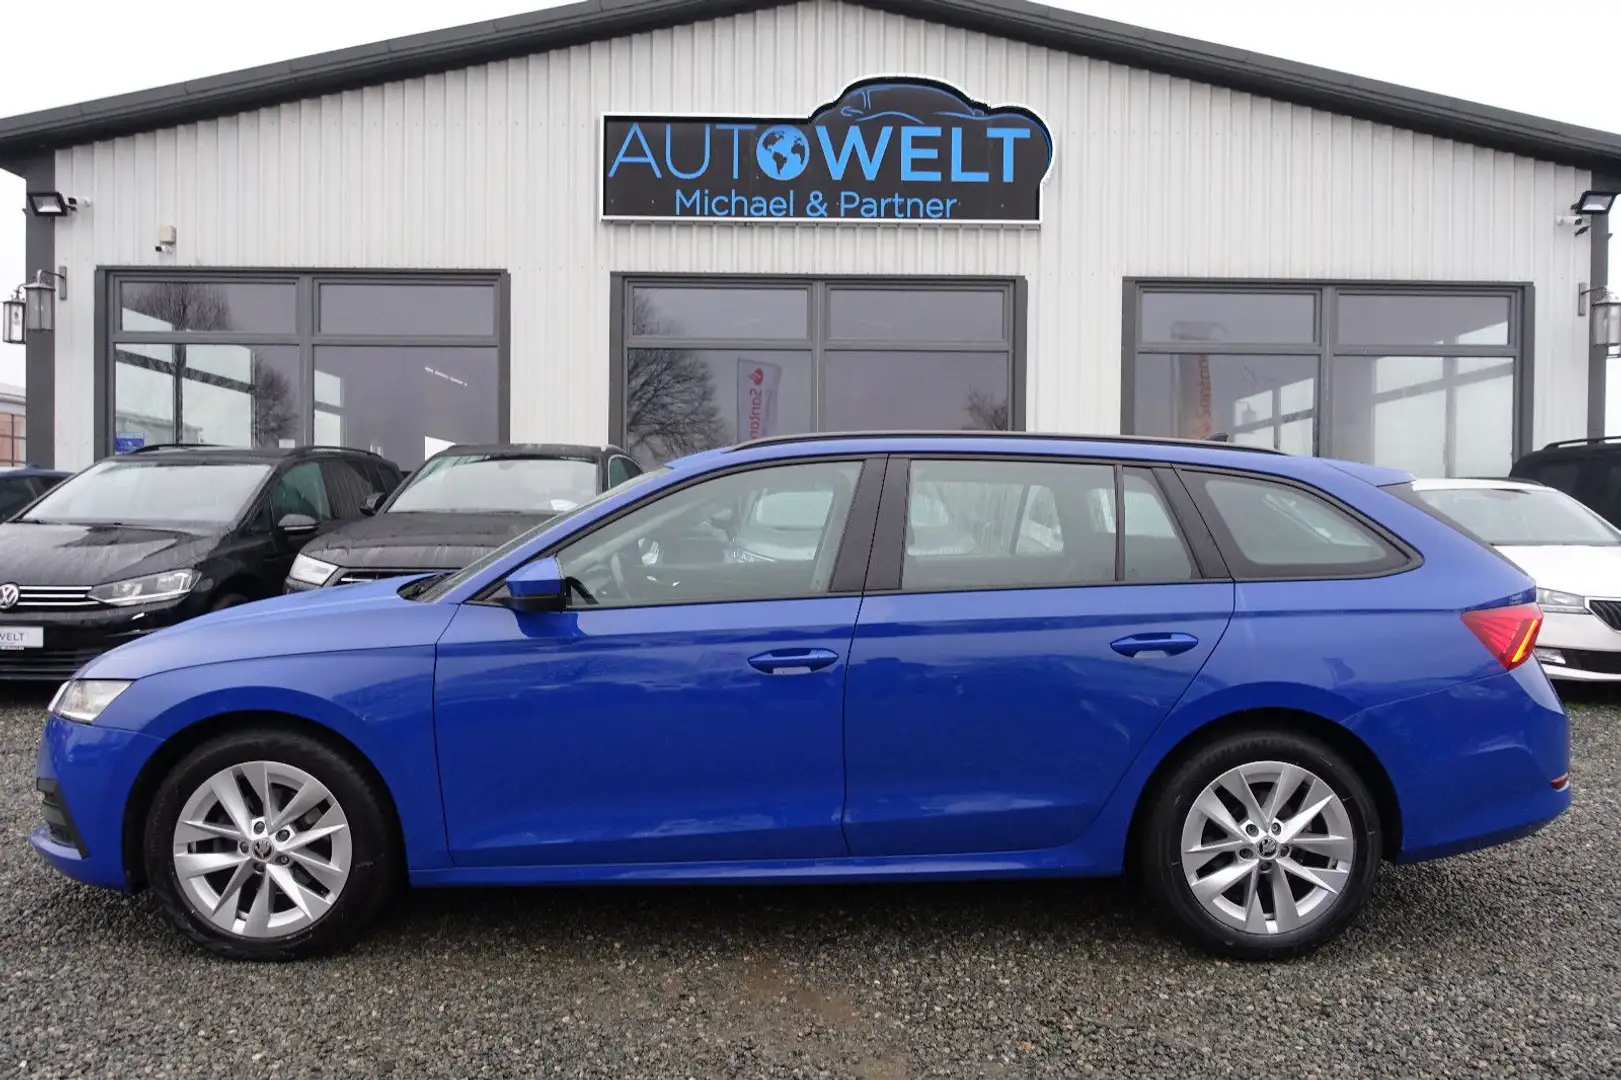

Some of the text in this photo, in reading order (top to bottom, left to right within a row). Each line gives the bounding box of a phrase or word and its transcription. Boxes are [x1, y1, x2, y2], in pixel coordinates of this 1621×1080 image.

[675, 188, 958, 219] Michael & Partner
